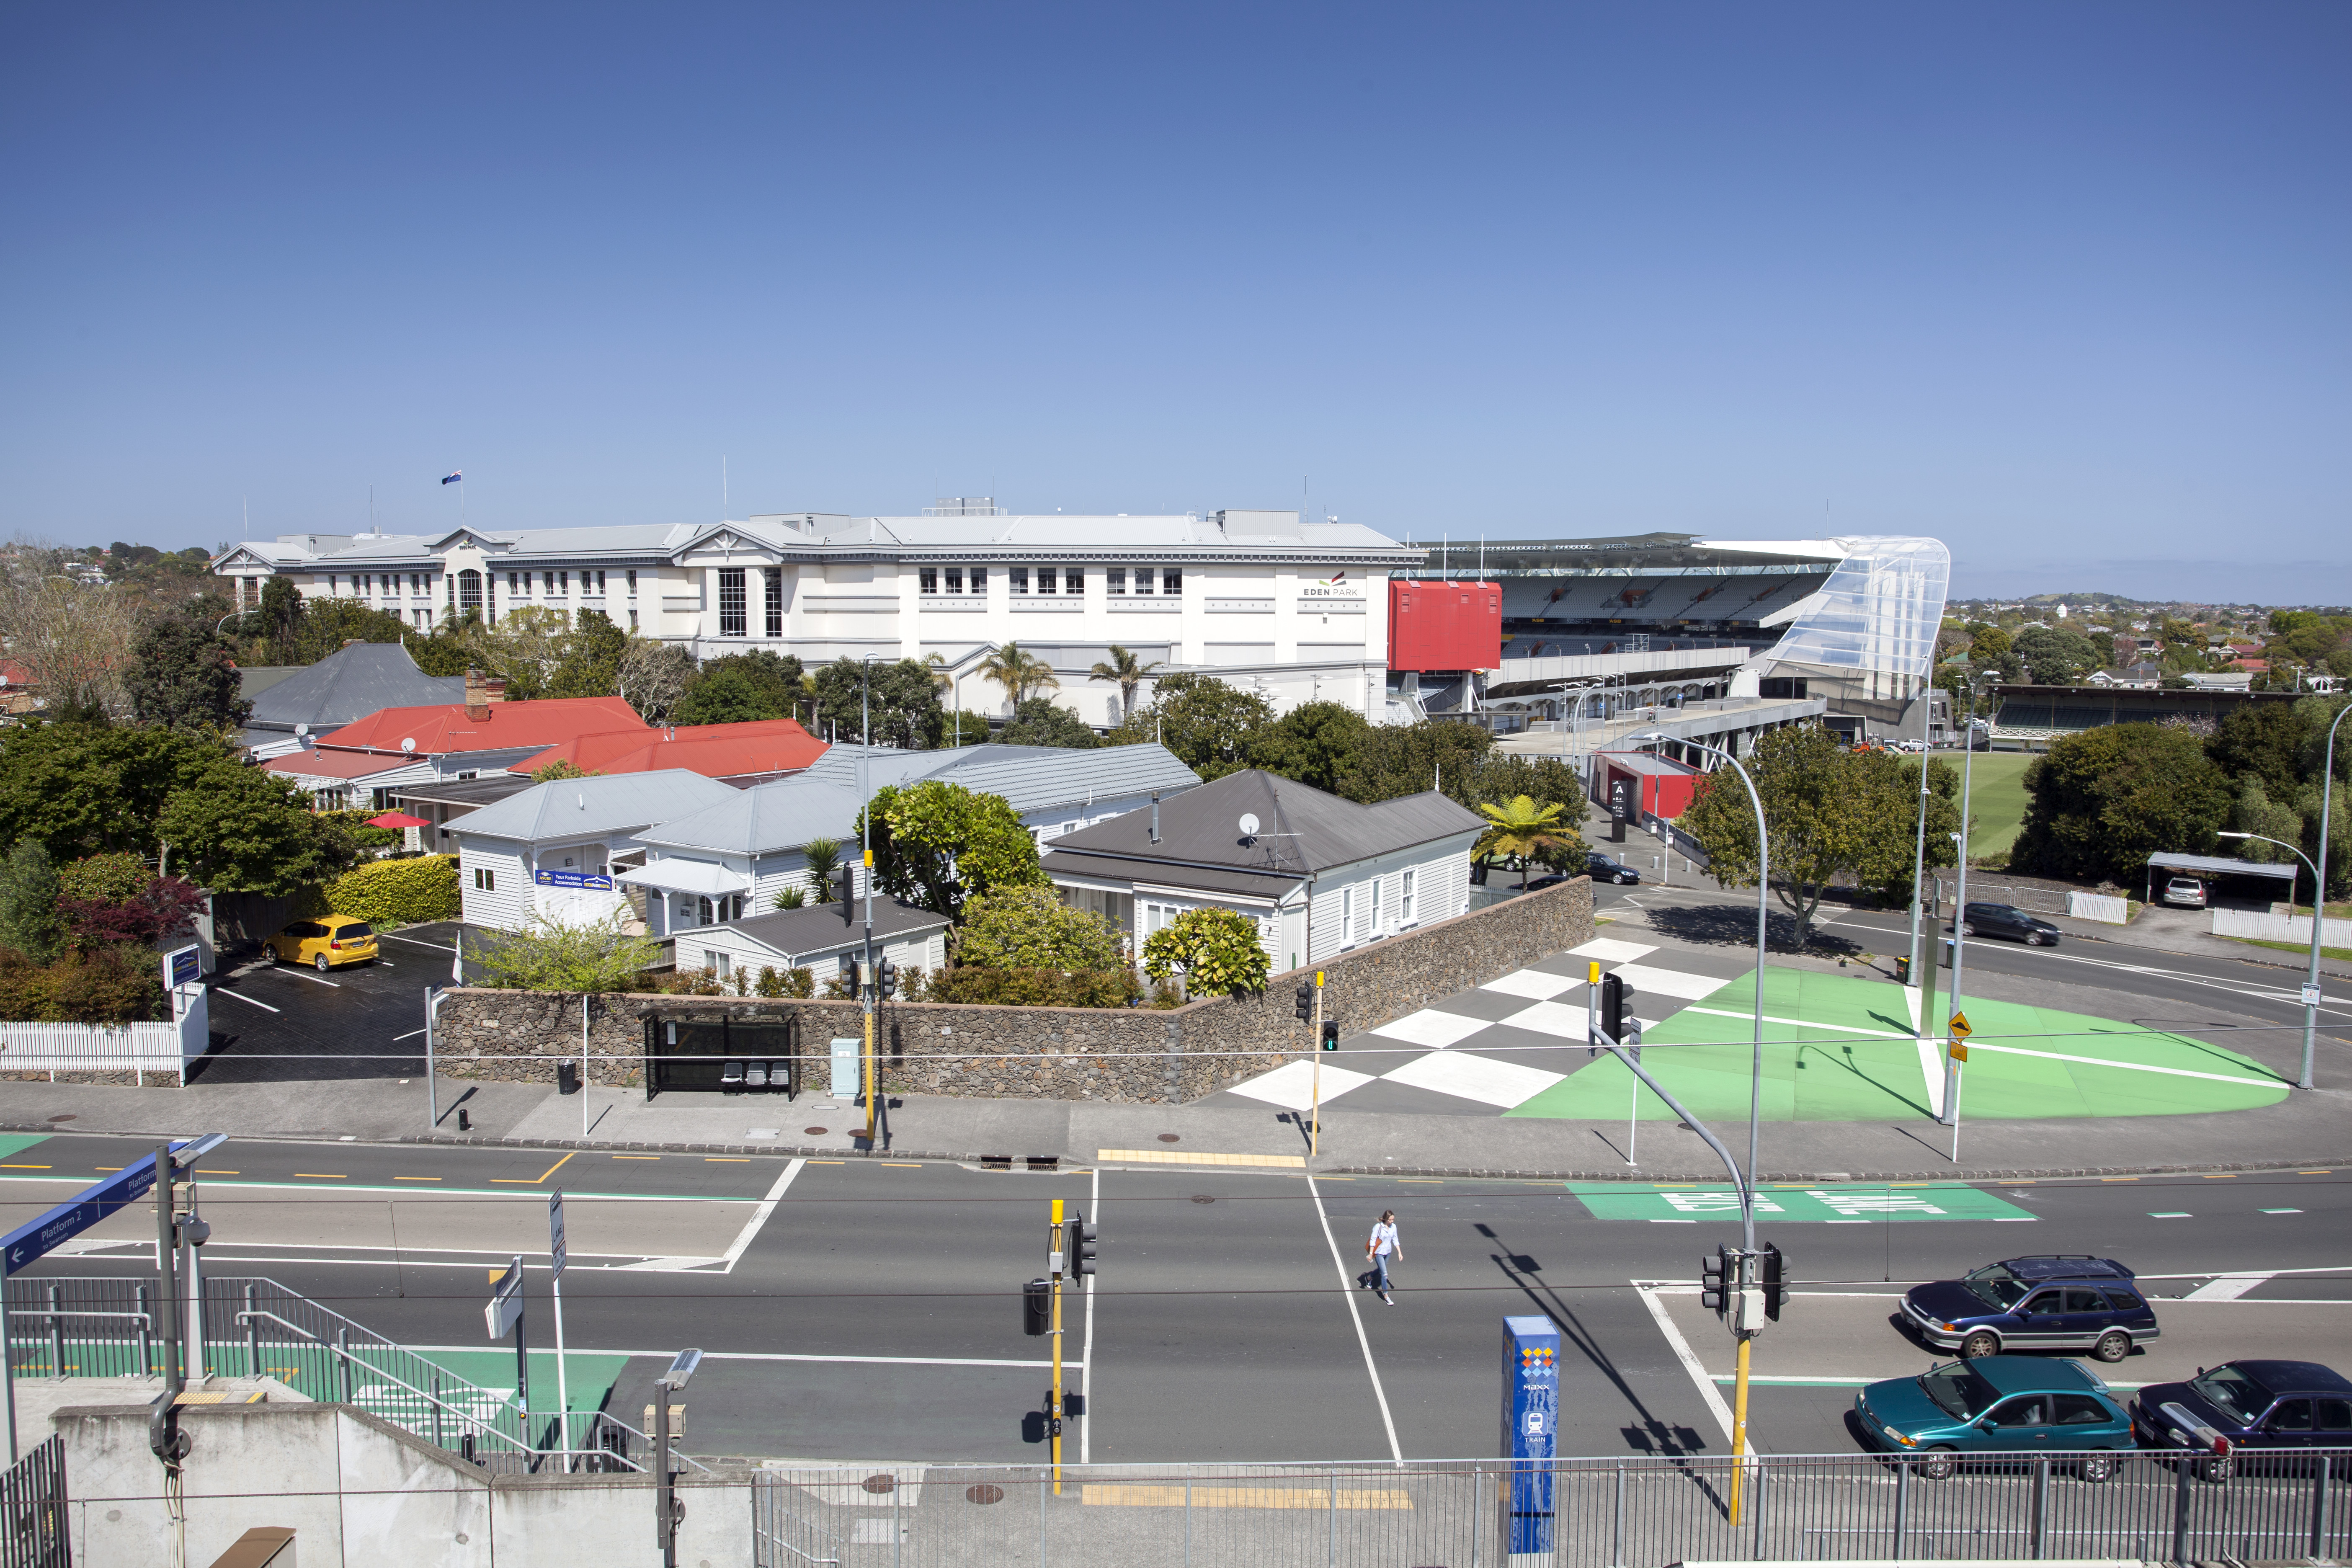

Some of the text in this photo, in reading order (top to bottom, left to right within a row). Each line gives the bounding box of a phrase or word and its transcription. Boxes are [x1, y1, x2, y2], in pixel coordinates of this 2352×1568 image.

[1615, 785, 1624, 794] A
[129, 1169, 157, 1191] Platform
[42, 1211, 82, 1241] Platform 2
[553, 1224, 562, 1242] LANE
[49, 1232, 68, 1246] Swanson
